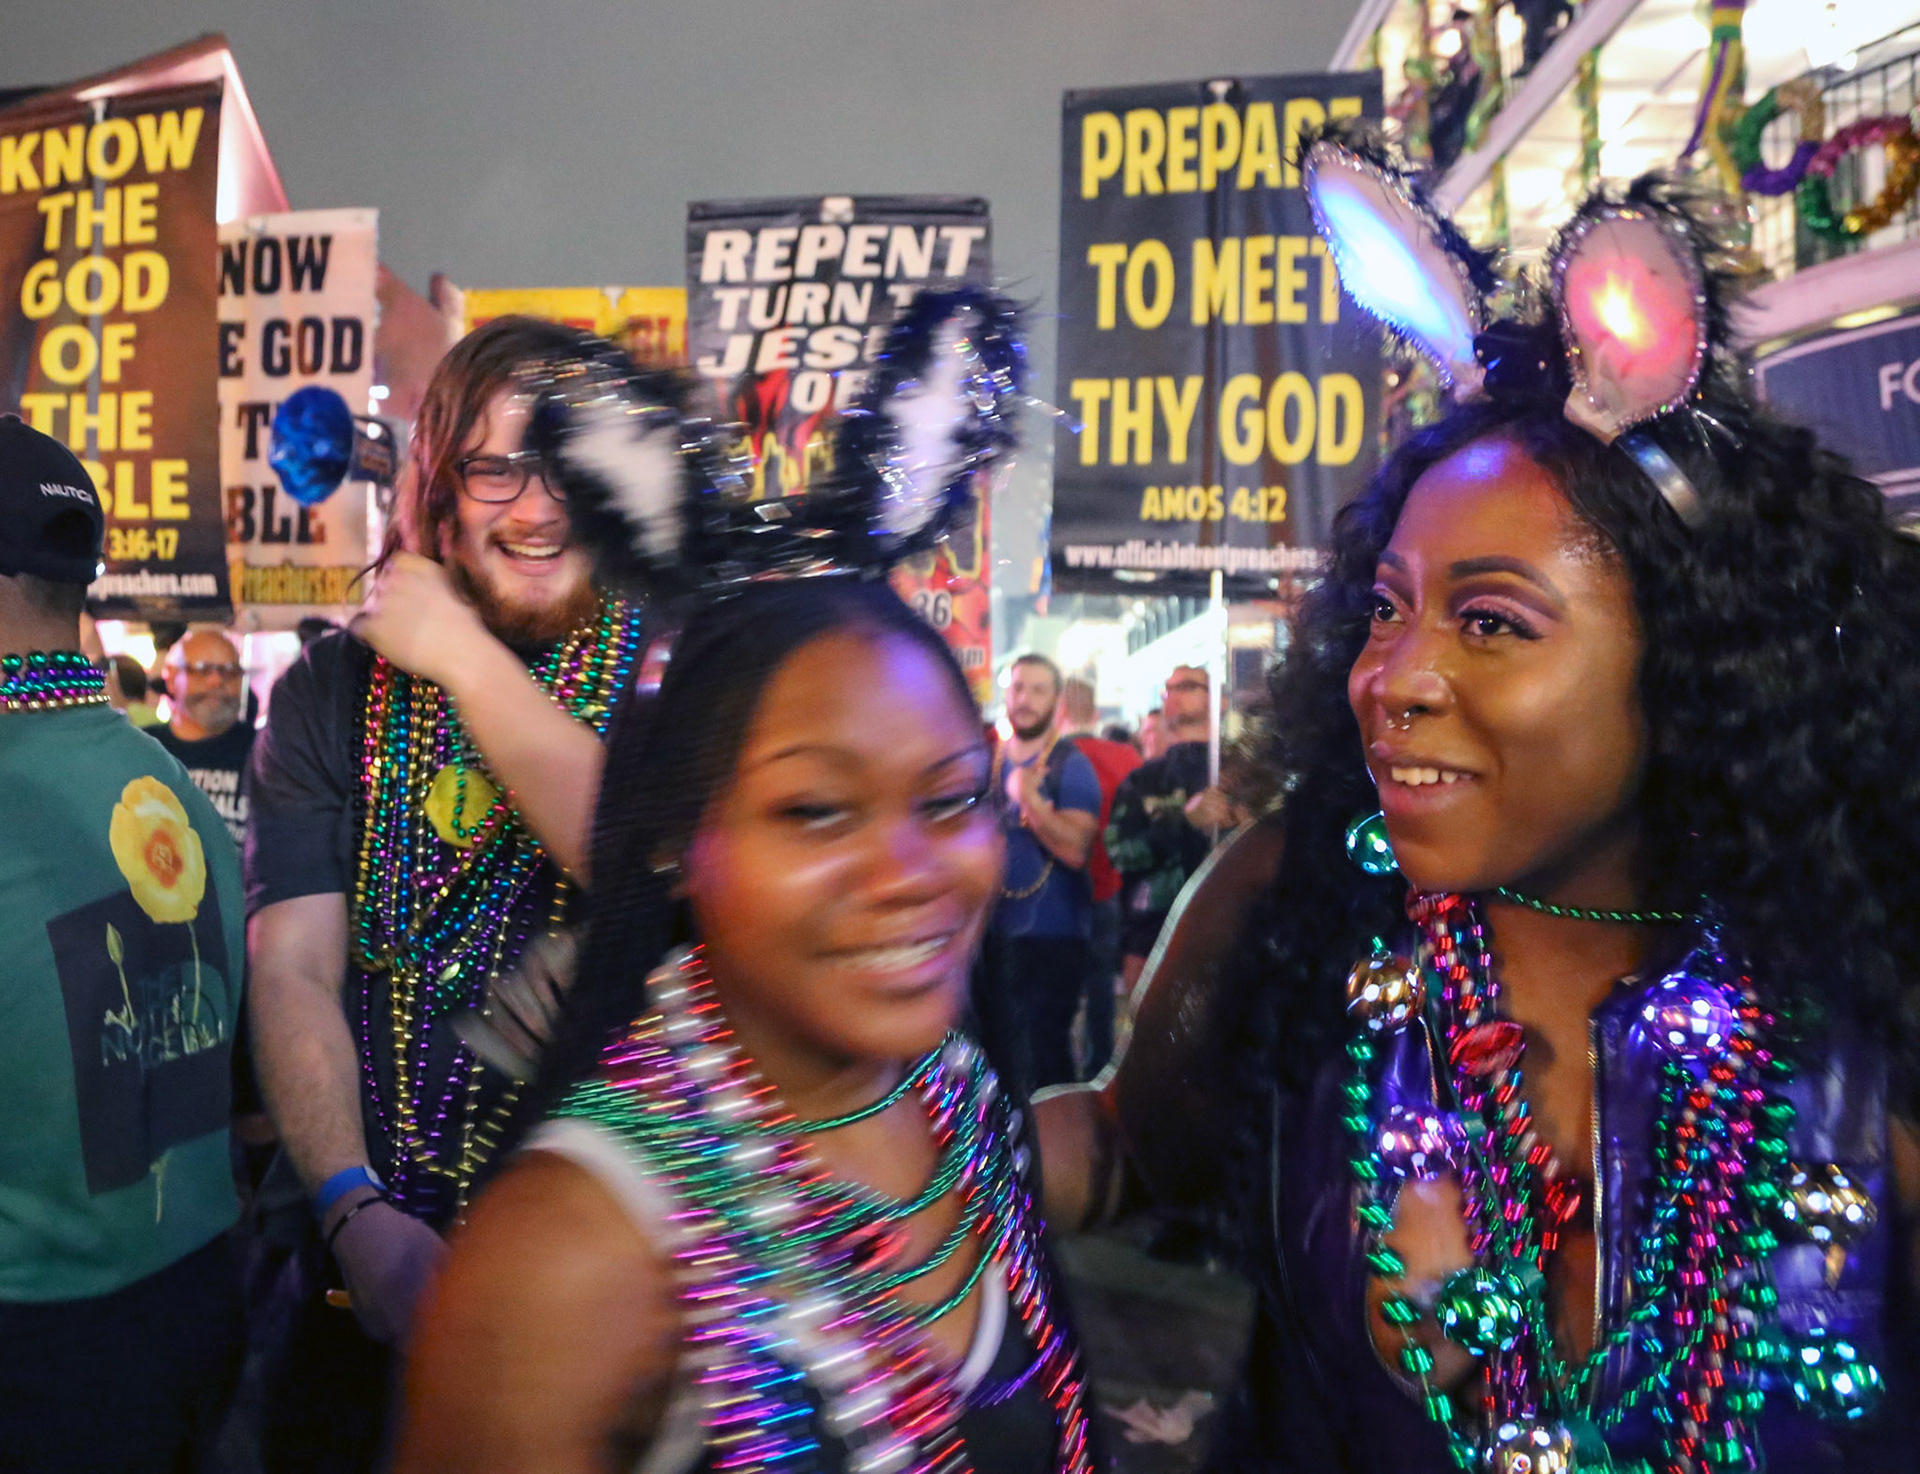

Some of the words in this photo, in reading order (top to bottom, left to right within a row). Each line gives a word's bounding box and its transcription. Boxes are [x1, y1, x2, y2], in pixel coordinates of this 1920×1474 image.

[0, 107, 204, 194] KNOW
[38, 183, 159, 251] THE
[219, 234, 333, 296] NOW
[700, 225, 986, 283] REPENT
[1087, 239, 1175, 330] TO
[1191, 234, 1340, 326] MEET
[21, 250, 170, 320] GOD
[713, 281, 873, 330] TURN
[38, 322, 135, 384] OF
[262, 316, 363, 377] GOD
[20, 390, 154, 451] THE
[1070, 375, 1204, 466] THY
[1218, 371, 1364, 466] GOD
[79, 458, 190, 520] BLE
[226, 486, 325, 545] BLE
[1140, 486, 1223, 521] AMOS
[1229, 487, 1287, 521] 4:12
[108, 528, 179, 560] 3:16-17
[1064, 539, 1320, 576] www.officialstreetpreachers
